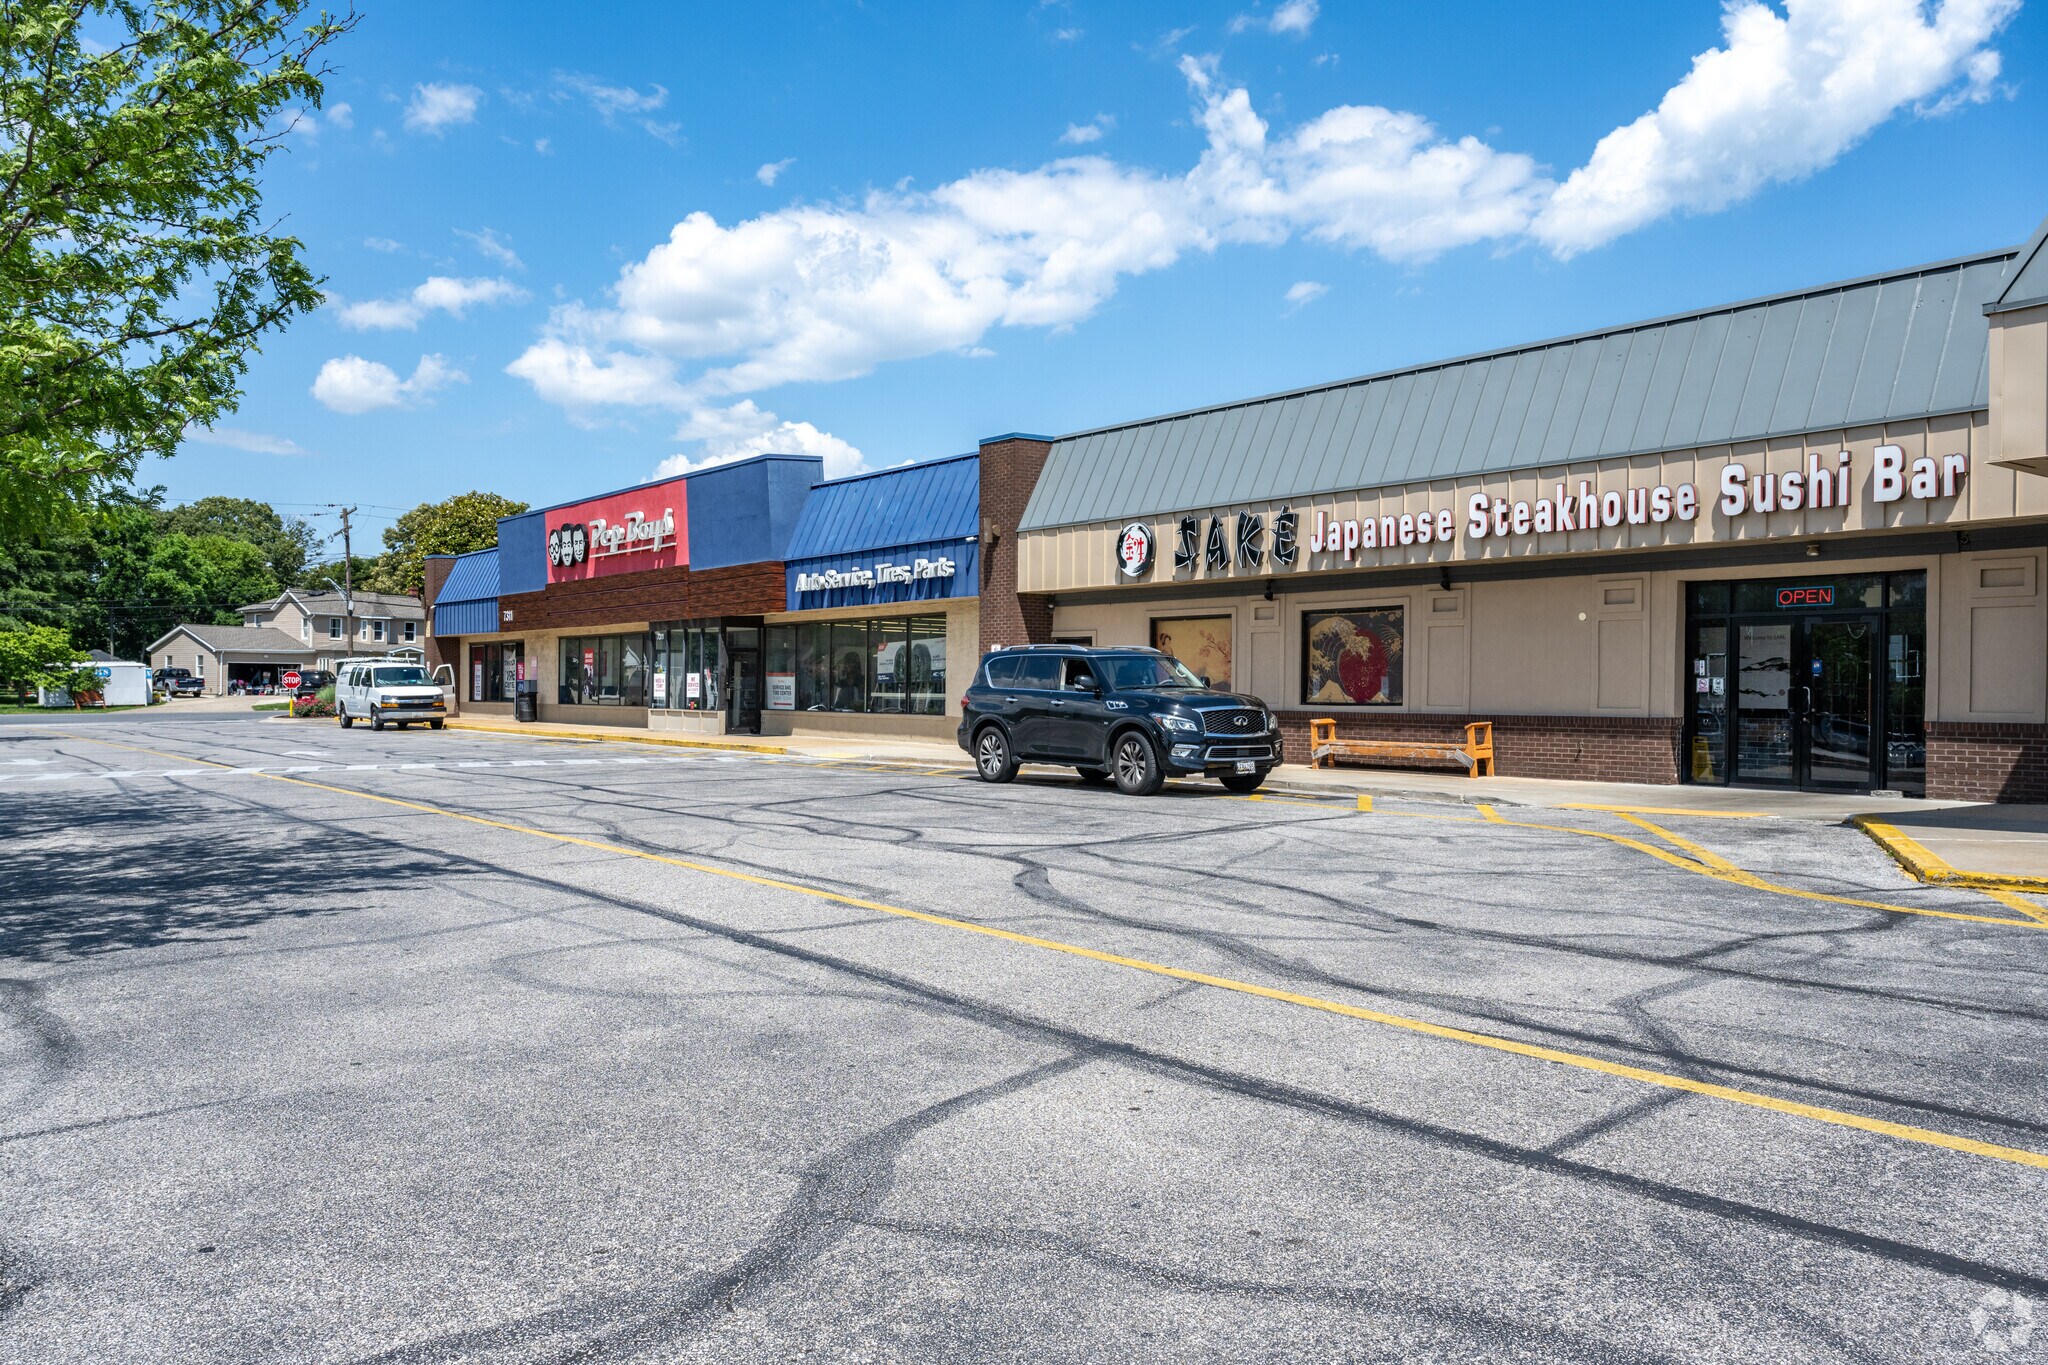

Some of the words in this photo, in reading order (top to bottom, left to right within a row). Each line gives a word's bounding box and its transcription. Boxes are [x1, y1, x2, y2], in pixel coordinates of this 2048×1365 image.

[1310, 507, 1455, 561] Japanese
[1468, 480, 1698, 539] Steakhouse
[1720, 450, 1852, 516] Sushi
[1873, 444, 1969, 502] Bar
[589, 518, 626, 553] Pep
[624, 507, 676, 552] Boys
[795, 572, 826, 592] Auto
[824, 566, 876, 589] Service,
[874, 562, 913, 584] Tires,
[913, 557, 956, 579] Parts
[1779, 588, 1832, 605] OPEN
[283, 676, 300, 684] STOP
